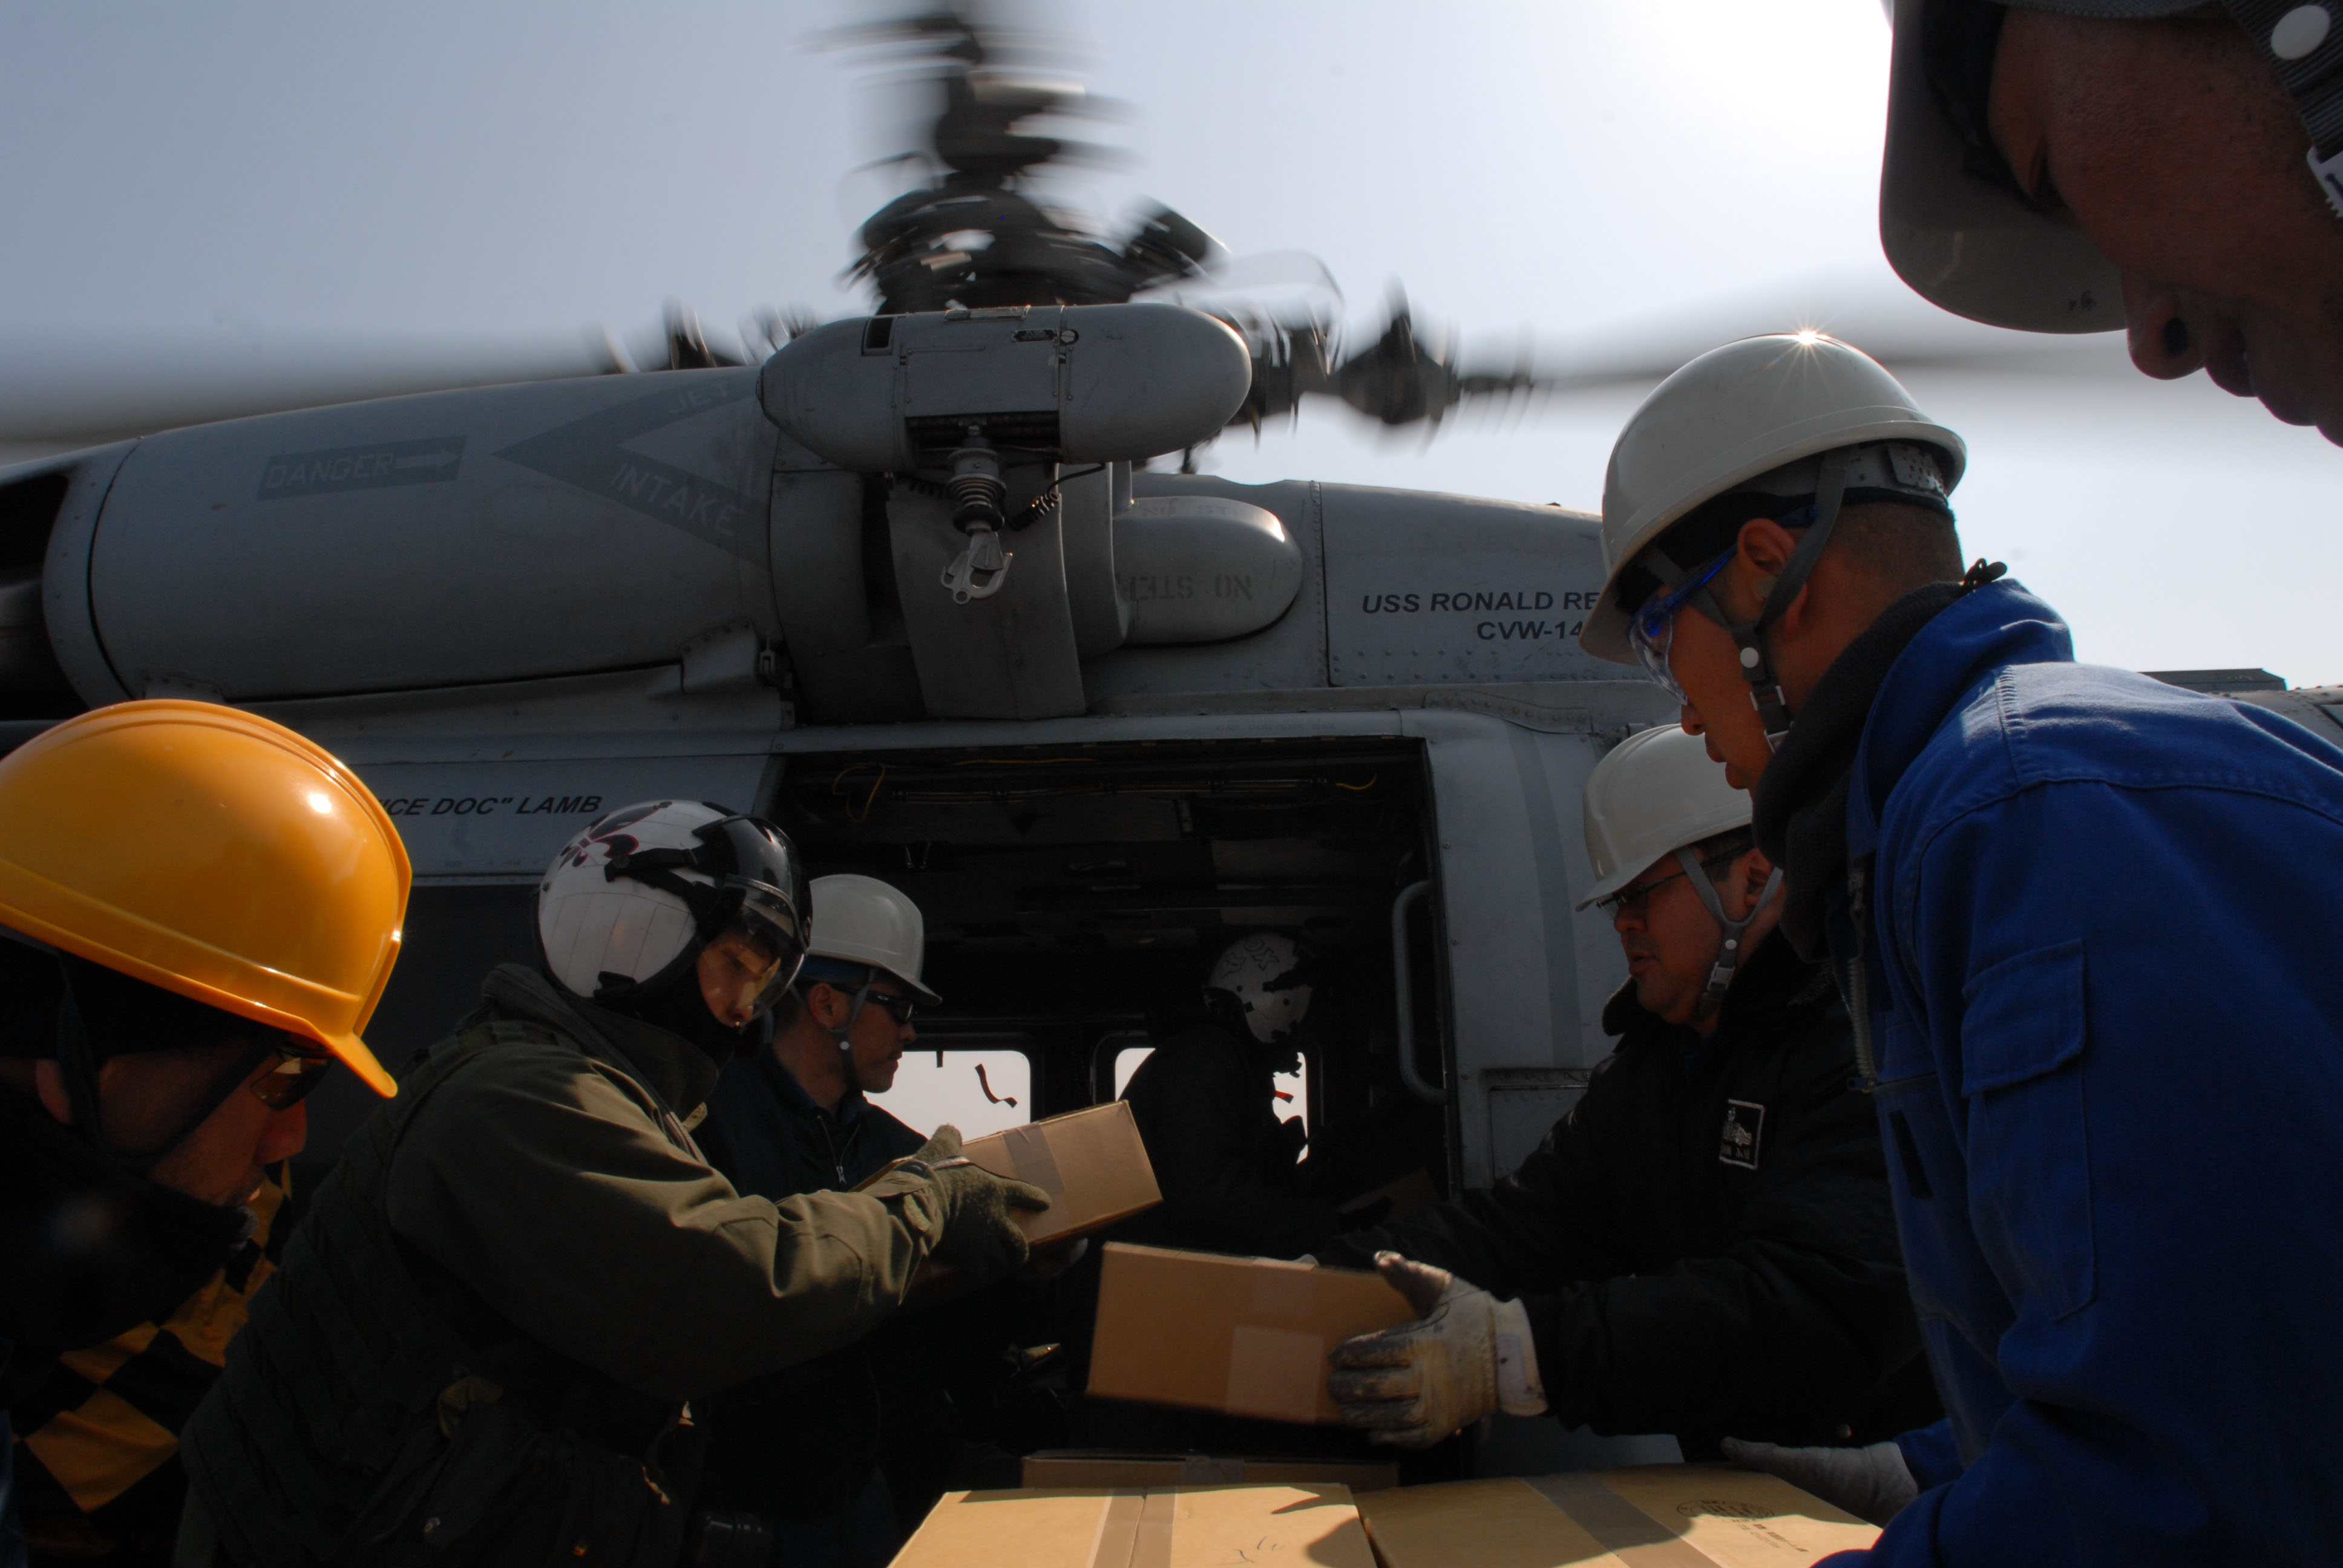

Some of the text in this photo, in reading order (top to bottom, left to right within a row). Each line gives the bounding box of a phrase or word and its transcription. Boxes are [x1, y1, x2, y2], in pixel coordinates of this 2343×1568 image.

[669, 381, 729, 414] JET
[266, 452, 395, 489] DANGER
[609, 463, 744, 537] INTAKE
[1214, 573, 1253, 601] NO
[1362, 594, 1420, 614] USS
[1430, 592, 1553, 611] RONALD
[1476, 621, 1583, 640] CVW-14
[431, 797, 513, 815] DOC"
[516, 795, 603, 814] LAMB
